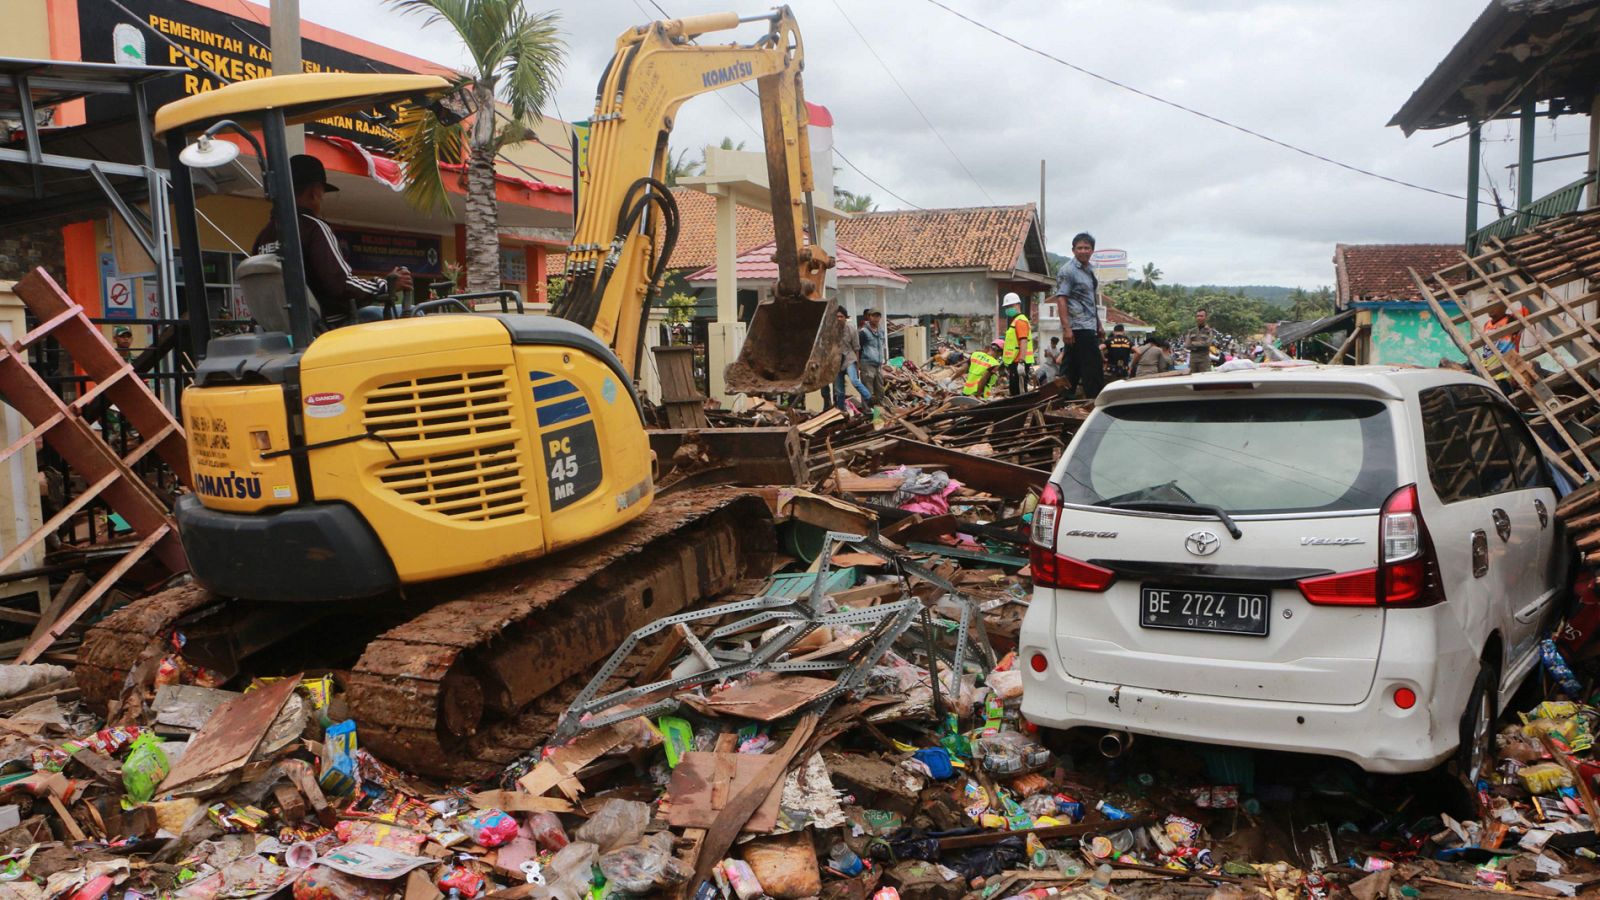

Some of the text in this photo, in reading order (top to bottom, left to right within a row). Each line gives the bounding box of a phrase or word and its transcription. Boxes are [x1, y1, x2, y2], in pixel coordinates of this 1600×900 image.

[149, 14, 243, 54] PEMERINTAH
[702, 60, 752, 87] KOMATSU
[549, 437, 571, 458] PC
[551, 455, 579, 481] 45
[554, 482, 575, 501] MR
[1149, 591, 1262, 620] BE 2724 DQ
[862, 809, 894, 820] GREAT
